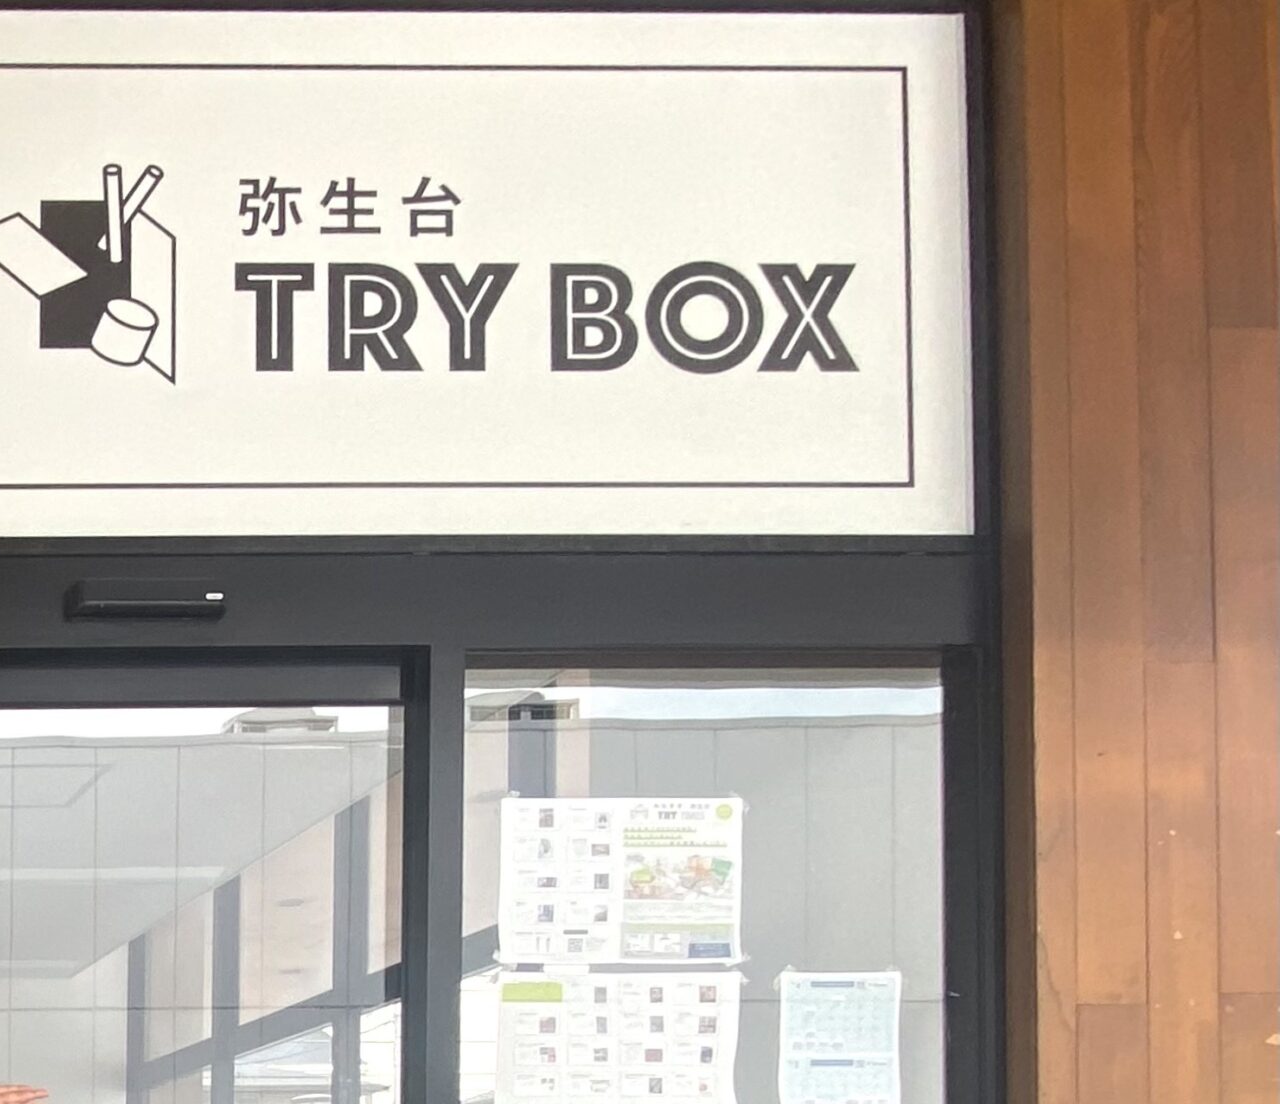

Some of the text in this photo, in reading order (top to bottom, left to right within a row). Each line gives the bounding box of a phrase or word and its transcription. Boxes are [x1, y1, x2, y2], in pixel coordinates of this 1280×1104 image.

[237, 176, 462, 238] 弥生台
[234, 259, 860, 375] TRY BOX
